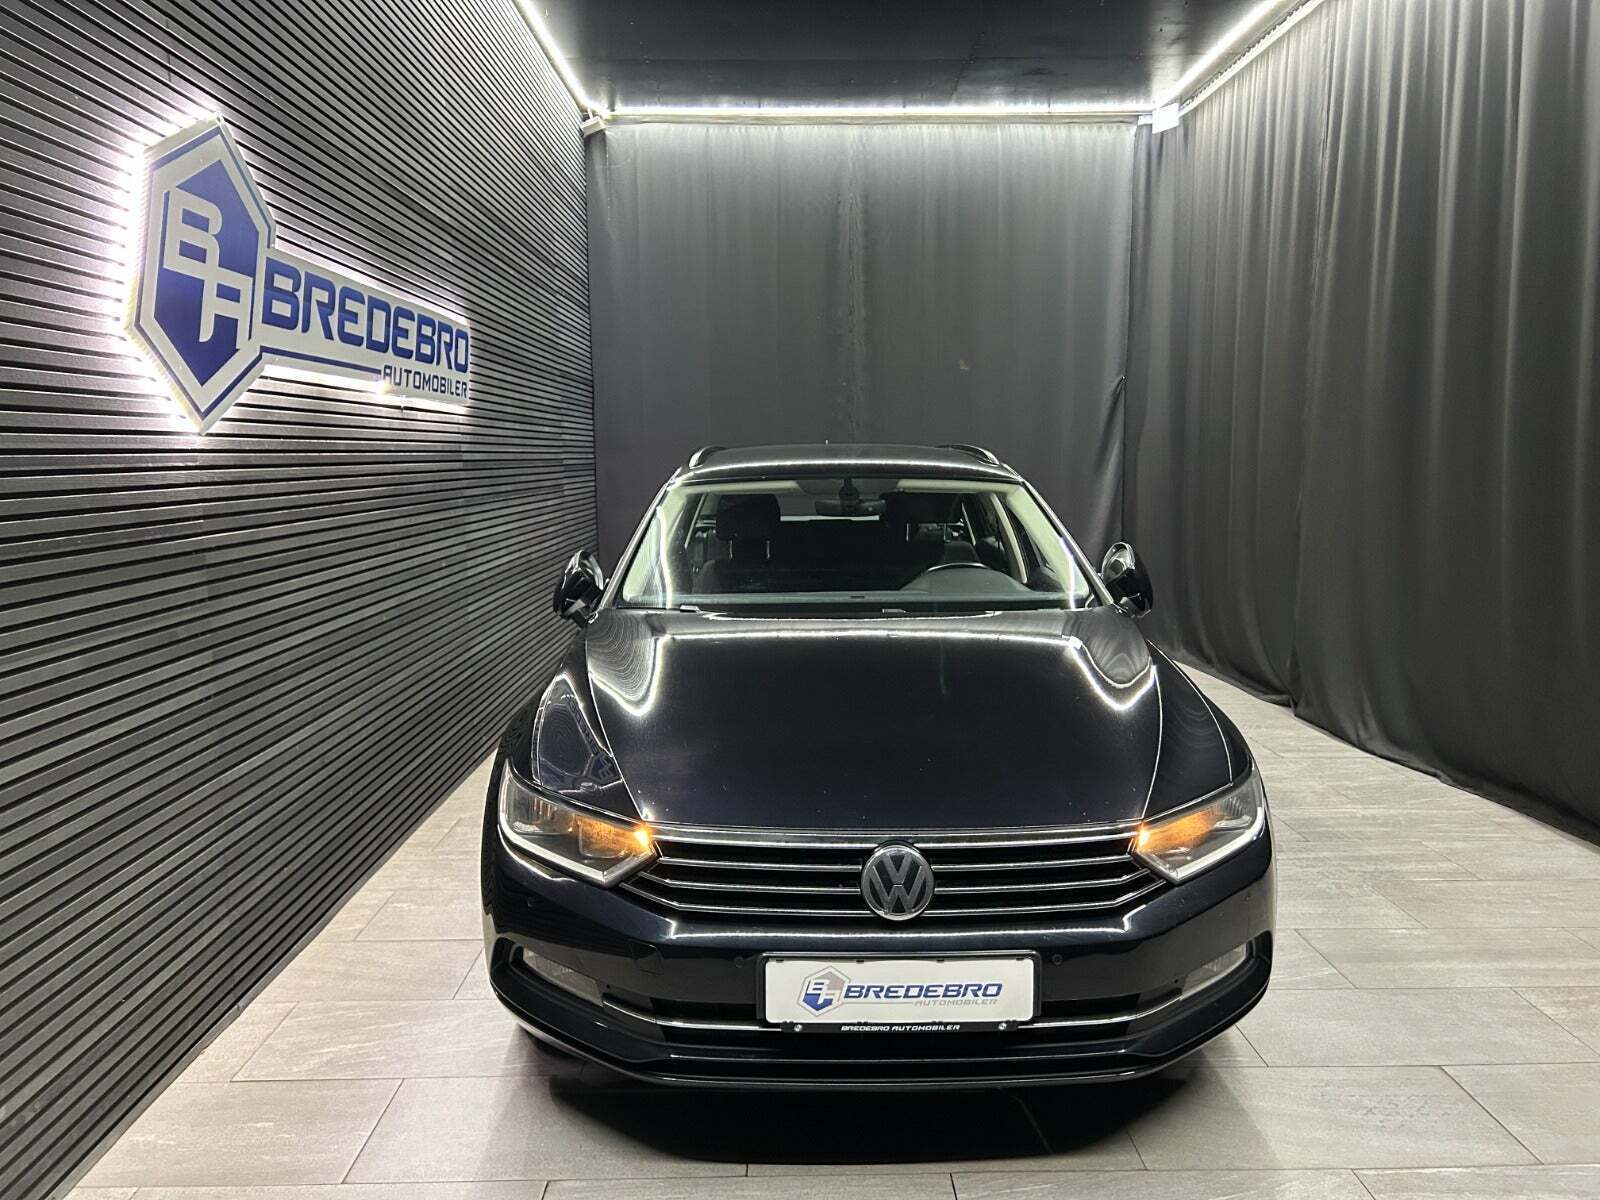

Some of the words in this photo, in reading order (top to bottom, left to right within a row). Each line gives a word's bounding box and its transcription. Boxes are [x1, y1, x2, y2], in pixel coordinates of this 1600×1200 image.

[261, 256, 469, 374] BREDEBRO
[383, 364, 468, 399] AUTOMOBILER
[843, 983, 1003, 999] BREDEBRO
[914, 998, 998, 1007] AUTOMOBILER
[841, 1024, 890, 1032] BREDEBRO
[891, 1024, 961, 1032] AUTOMOBILER
